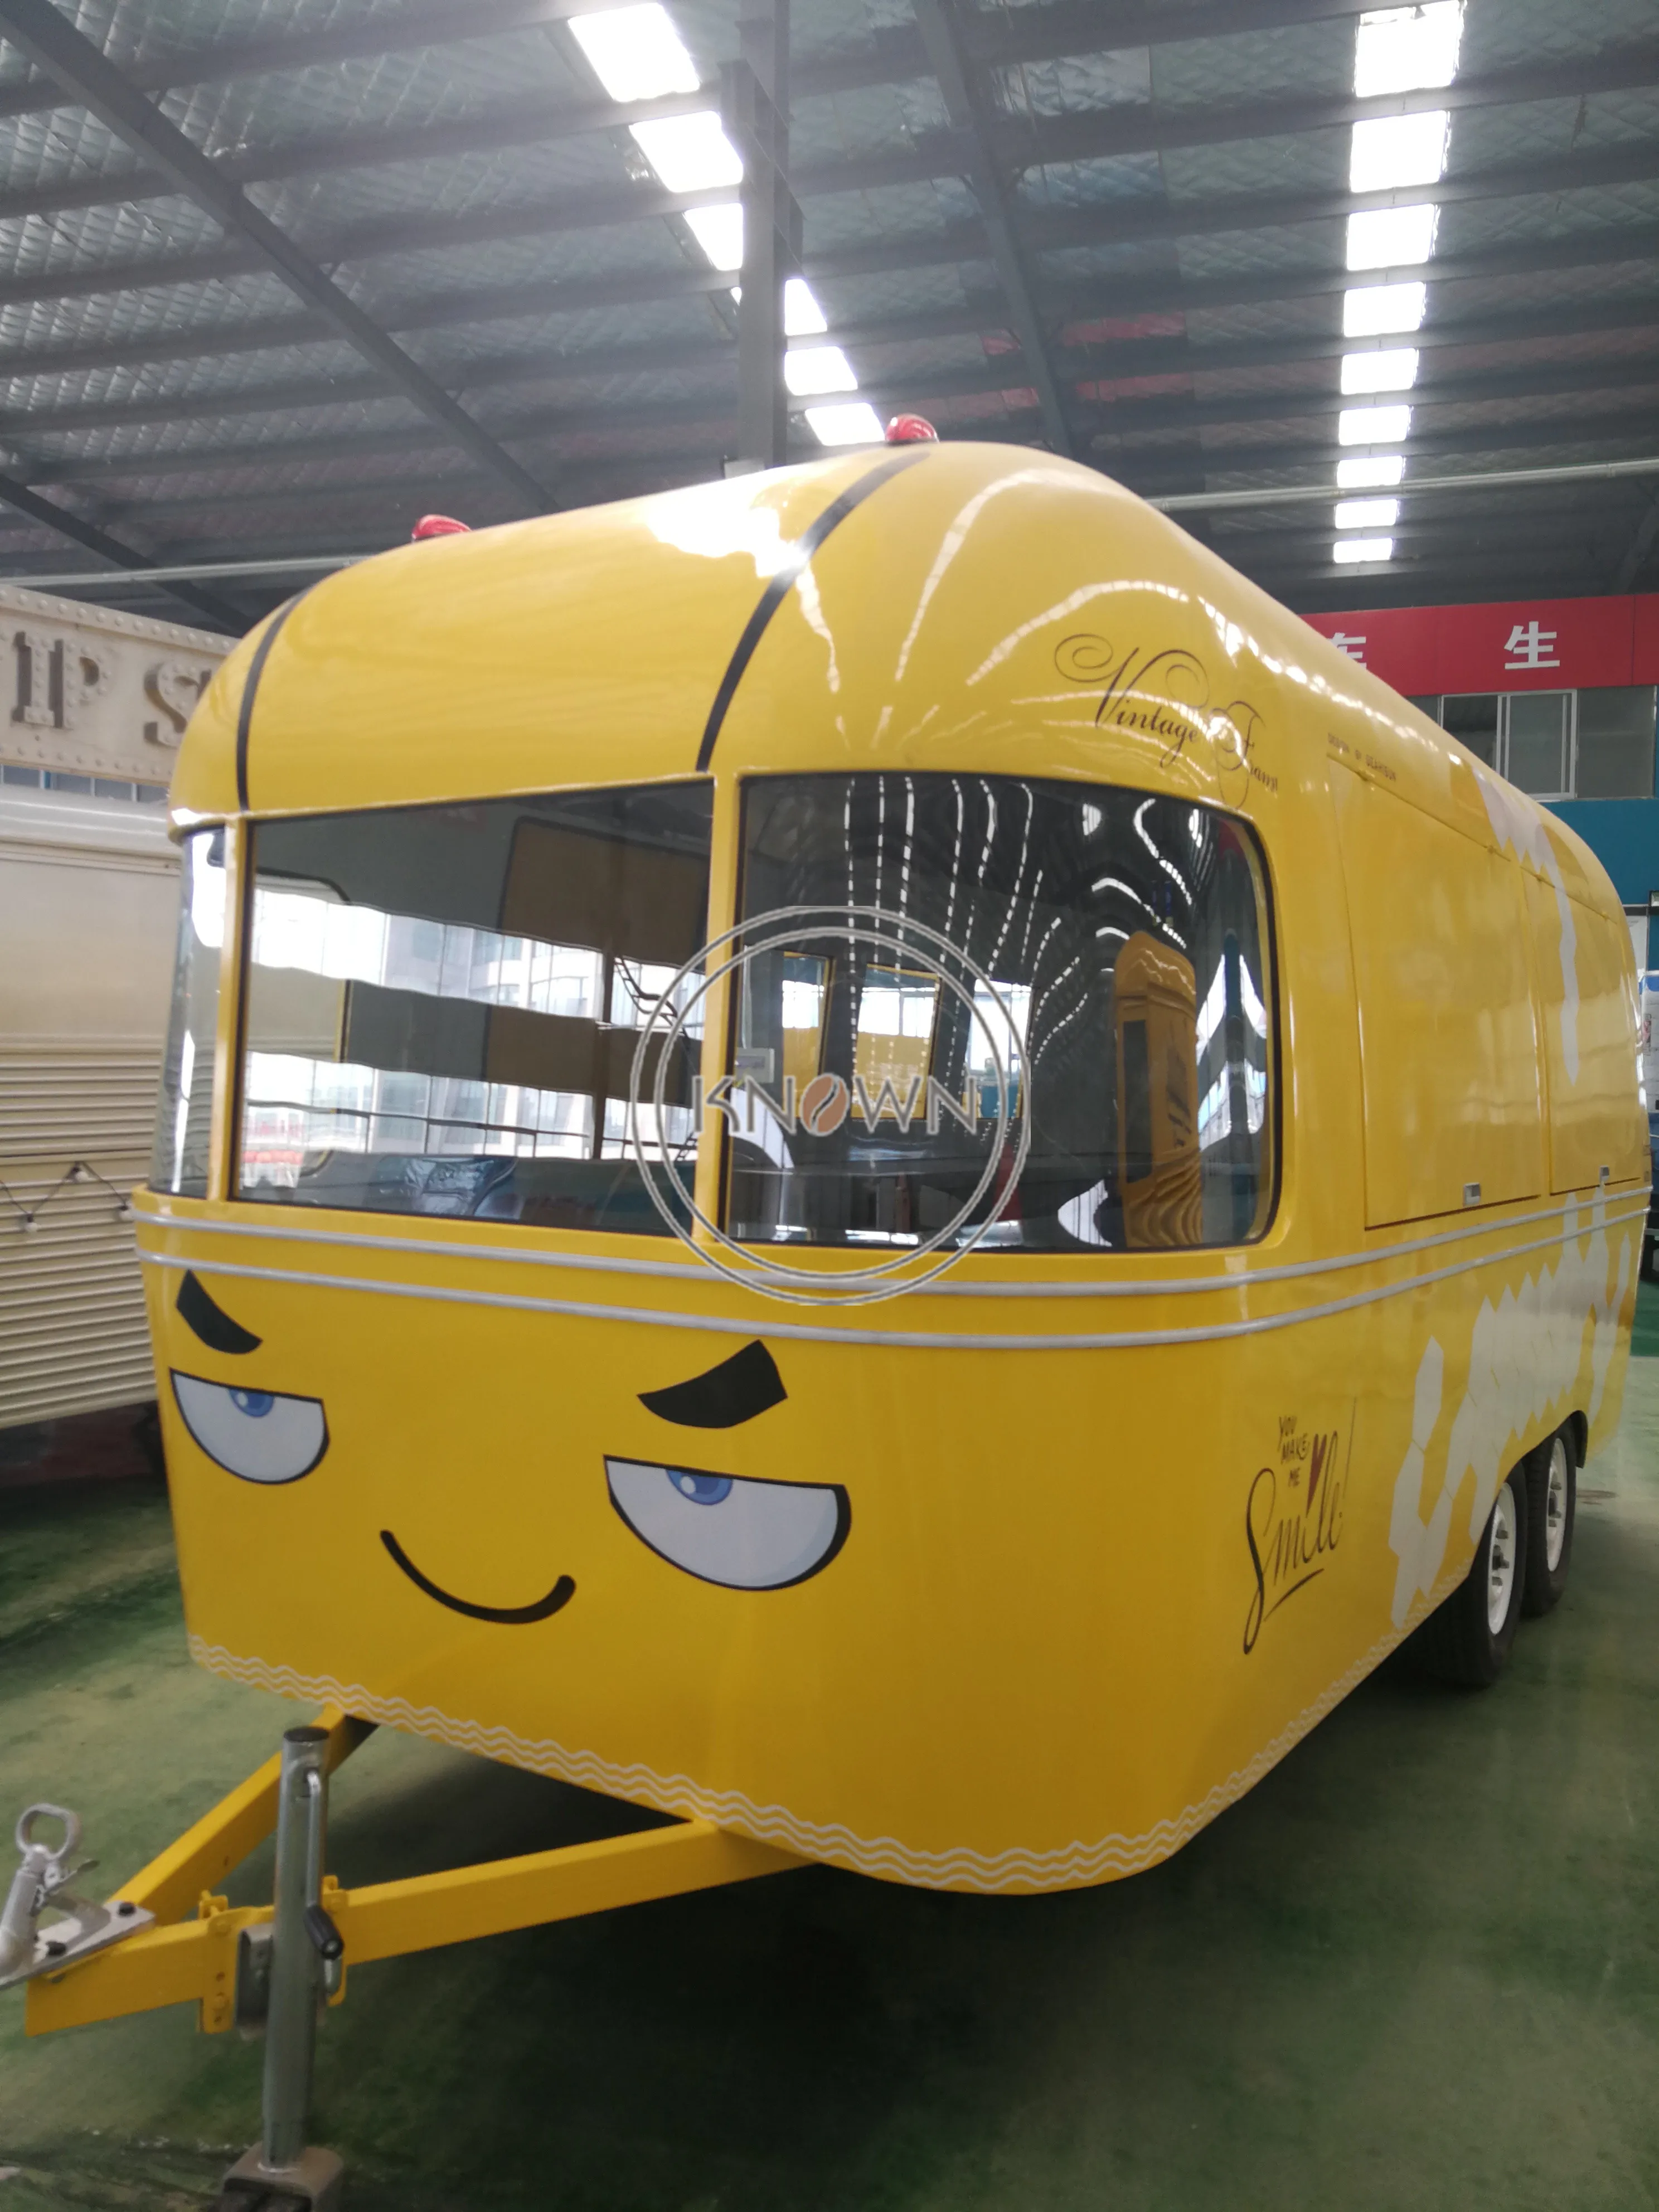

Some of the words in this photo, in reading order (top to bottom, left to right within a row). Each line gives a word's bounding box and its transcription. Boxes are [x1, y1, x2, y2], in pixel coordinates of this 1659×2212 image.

[1504, 621, 1560, 670] 生
[143, 660, 212, 749] S
[1054, 633, 1210, 768] Vintage
